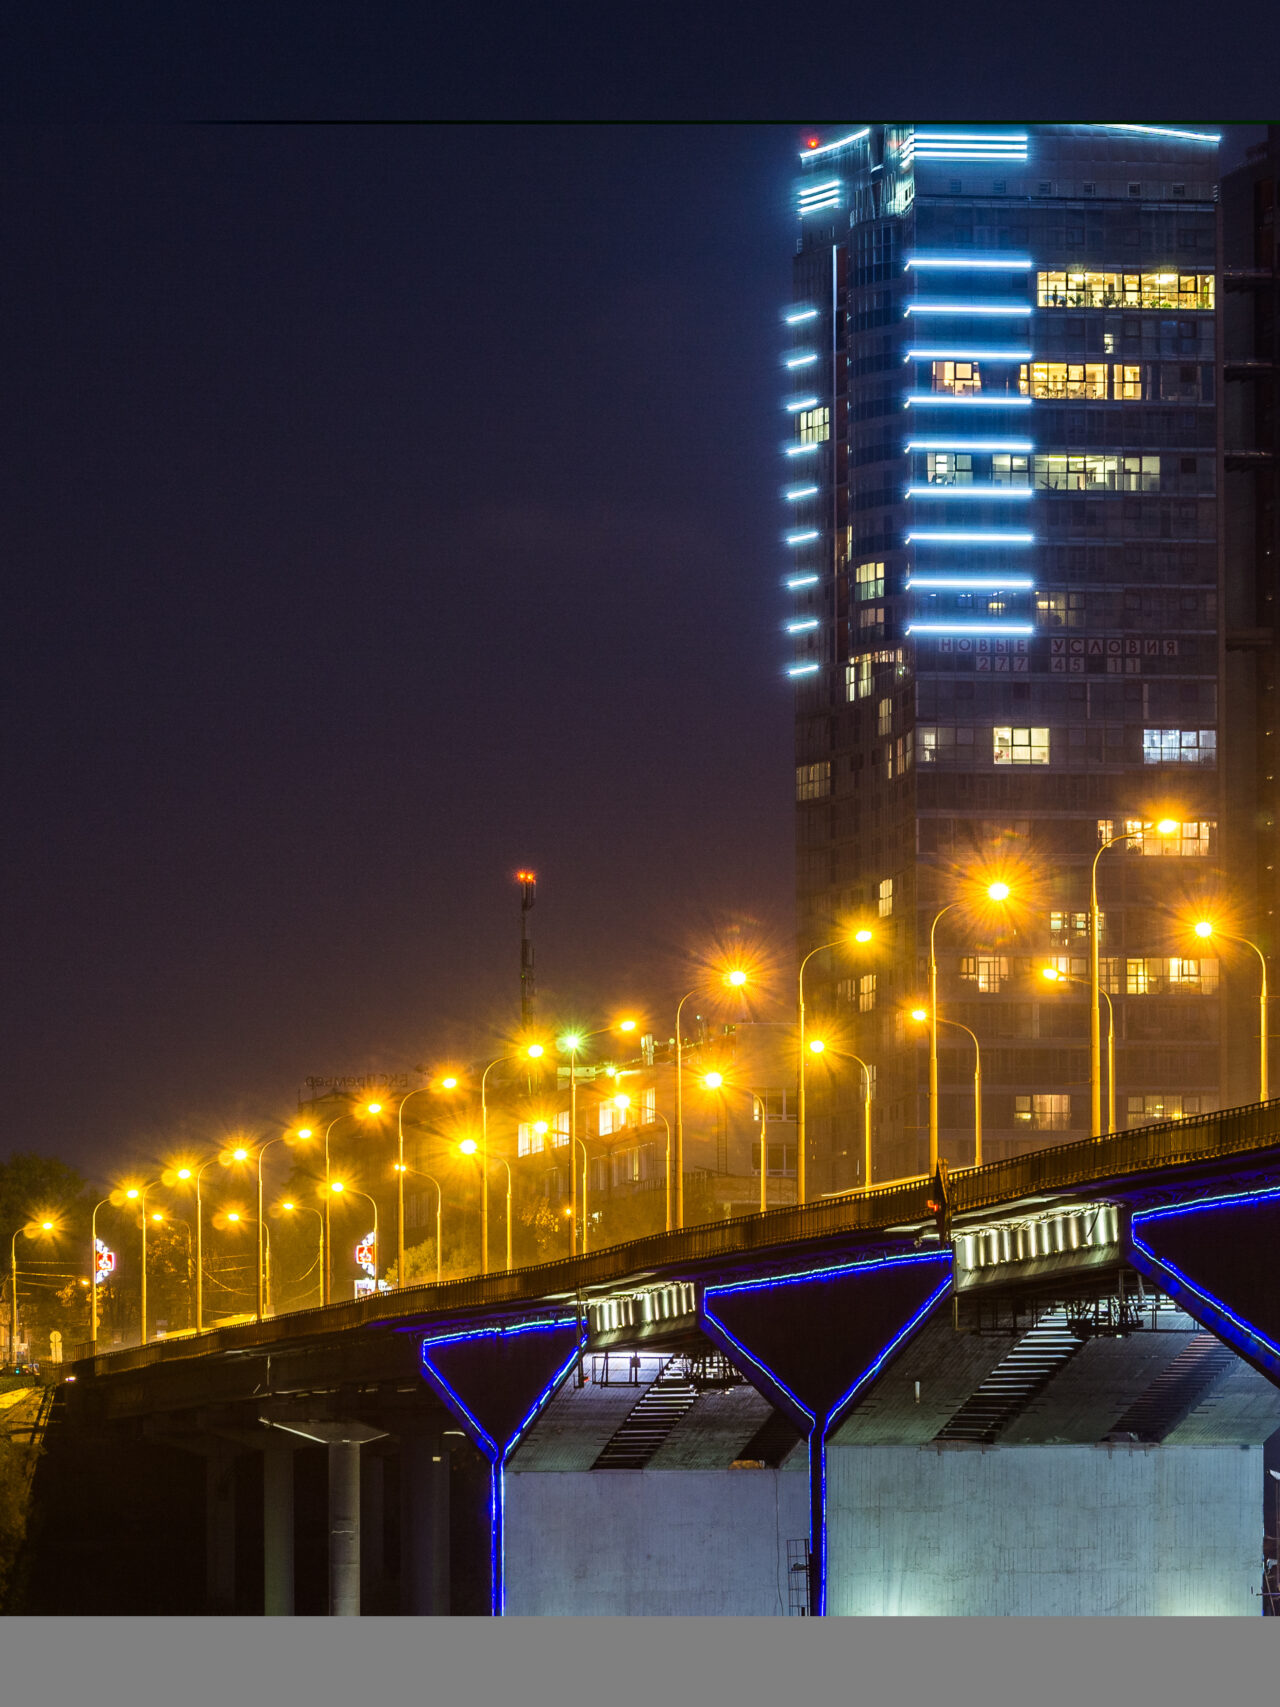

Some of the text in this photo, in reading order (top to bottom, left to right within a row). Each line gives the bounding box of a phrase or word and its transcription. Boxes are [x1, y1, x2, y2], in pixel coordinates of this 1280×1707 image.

[940, 639, 1176, 654] НОВЫЕ УСЛОВИЯ
[978, 657, 1139, 672] 277 45 11
